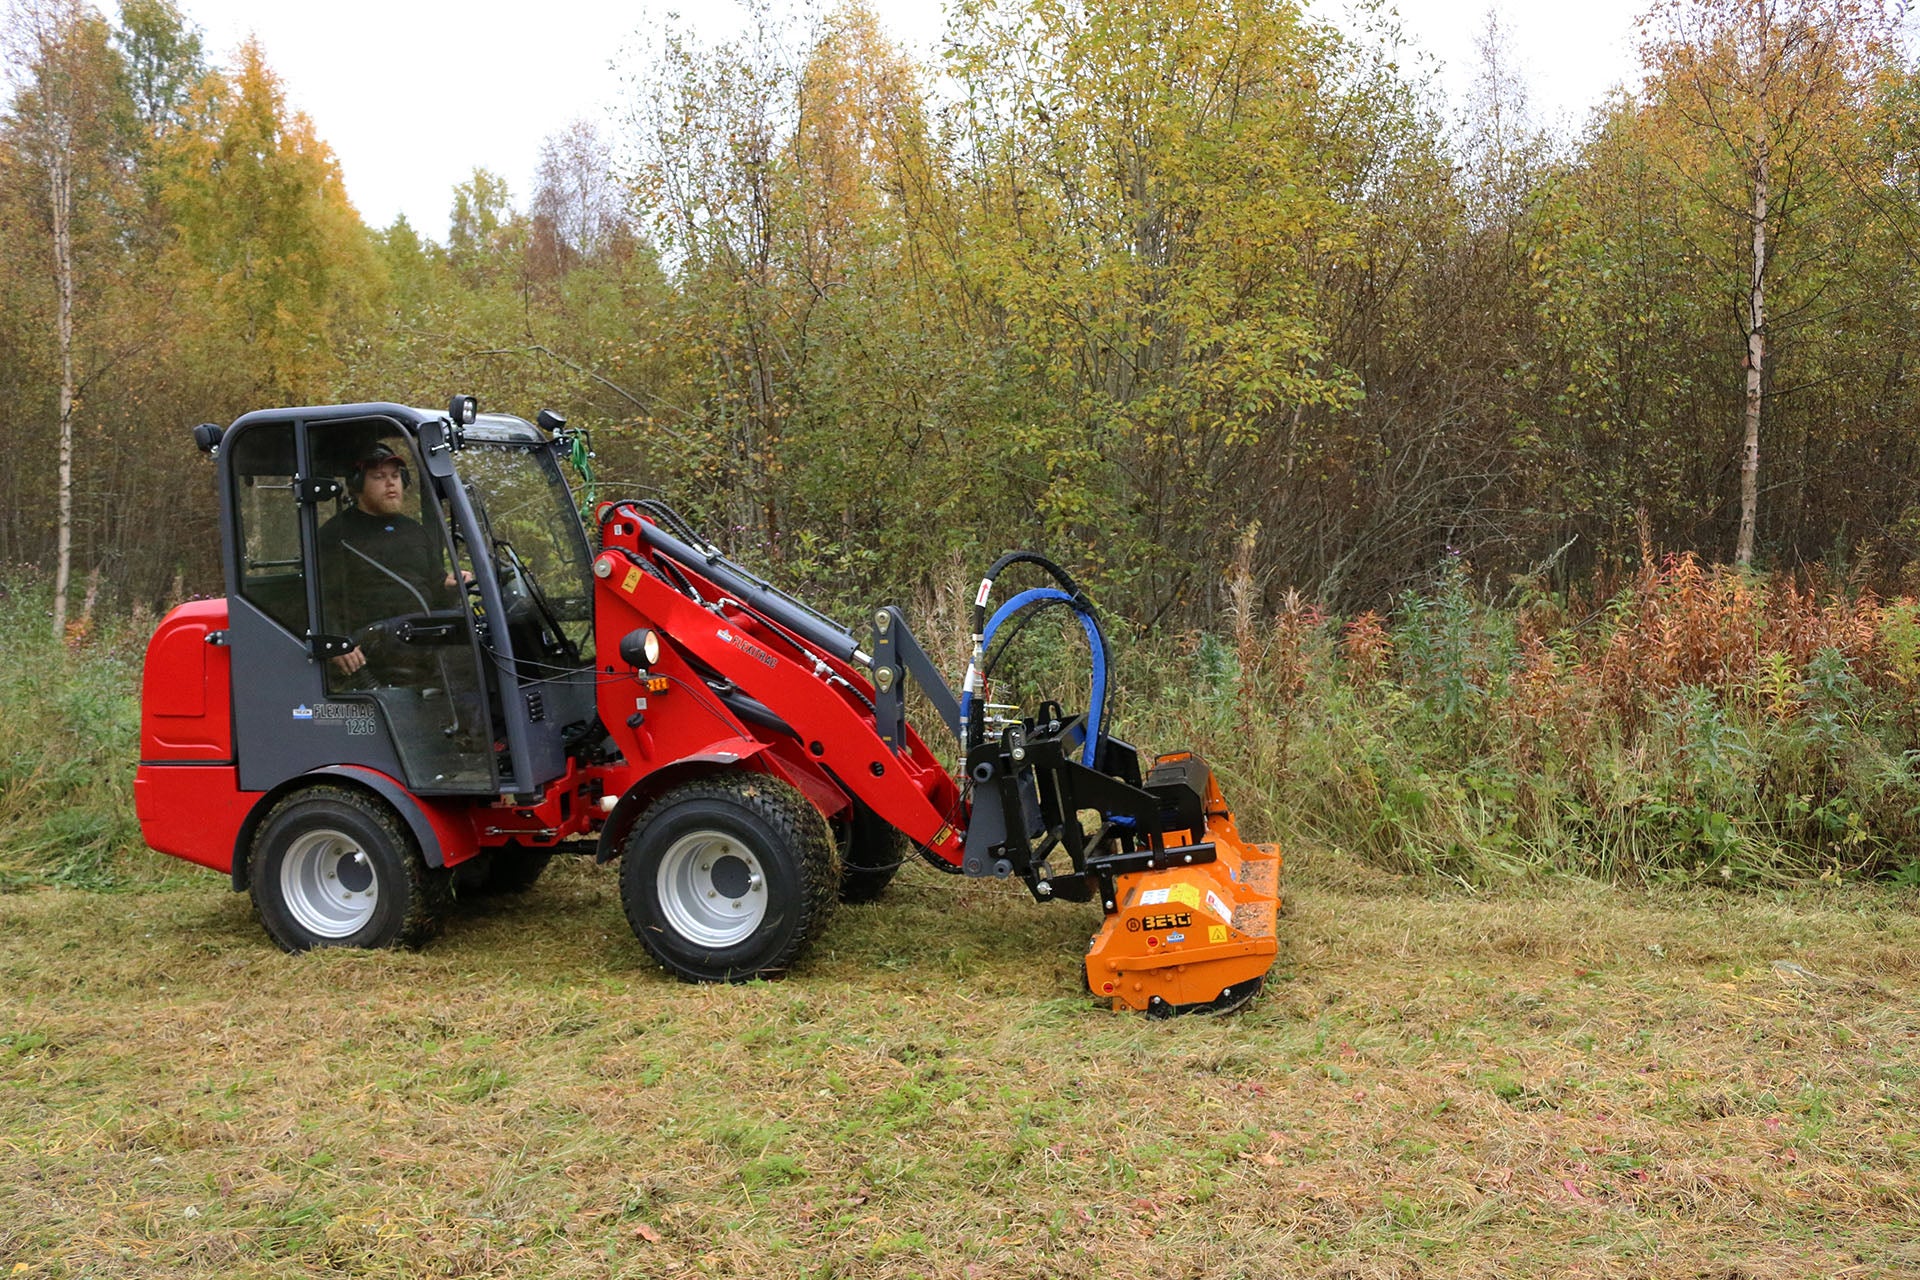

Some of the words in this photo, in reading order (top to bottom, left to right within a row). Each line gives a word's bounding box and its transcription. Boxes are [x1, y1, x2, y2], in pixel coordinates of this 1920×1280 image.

[732, 635, 778, 669] FLEXITRAC
[313, 704, 375, 719] FLEXITRAC
[345, 719, 376, 735] 1236
